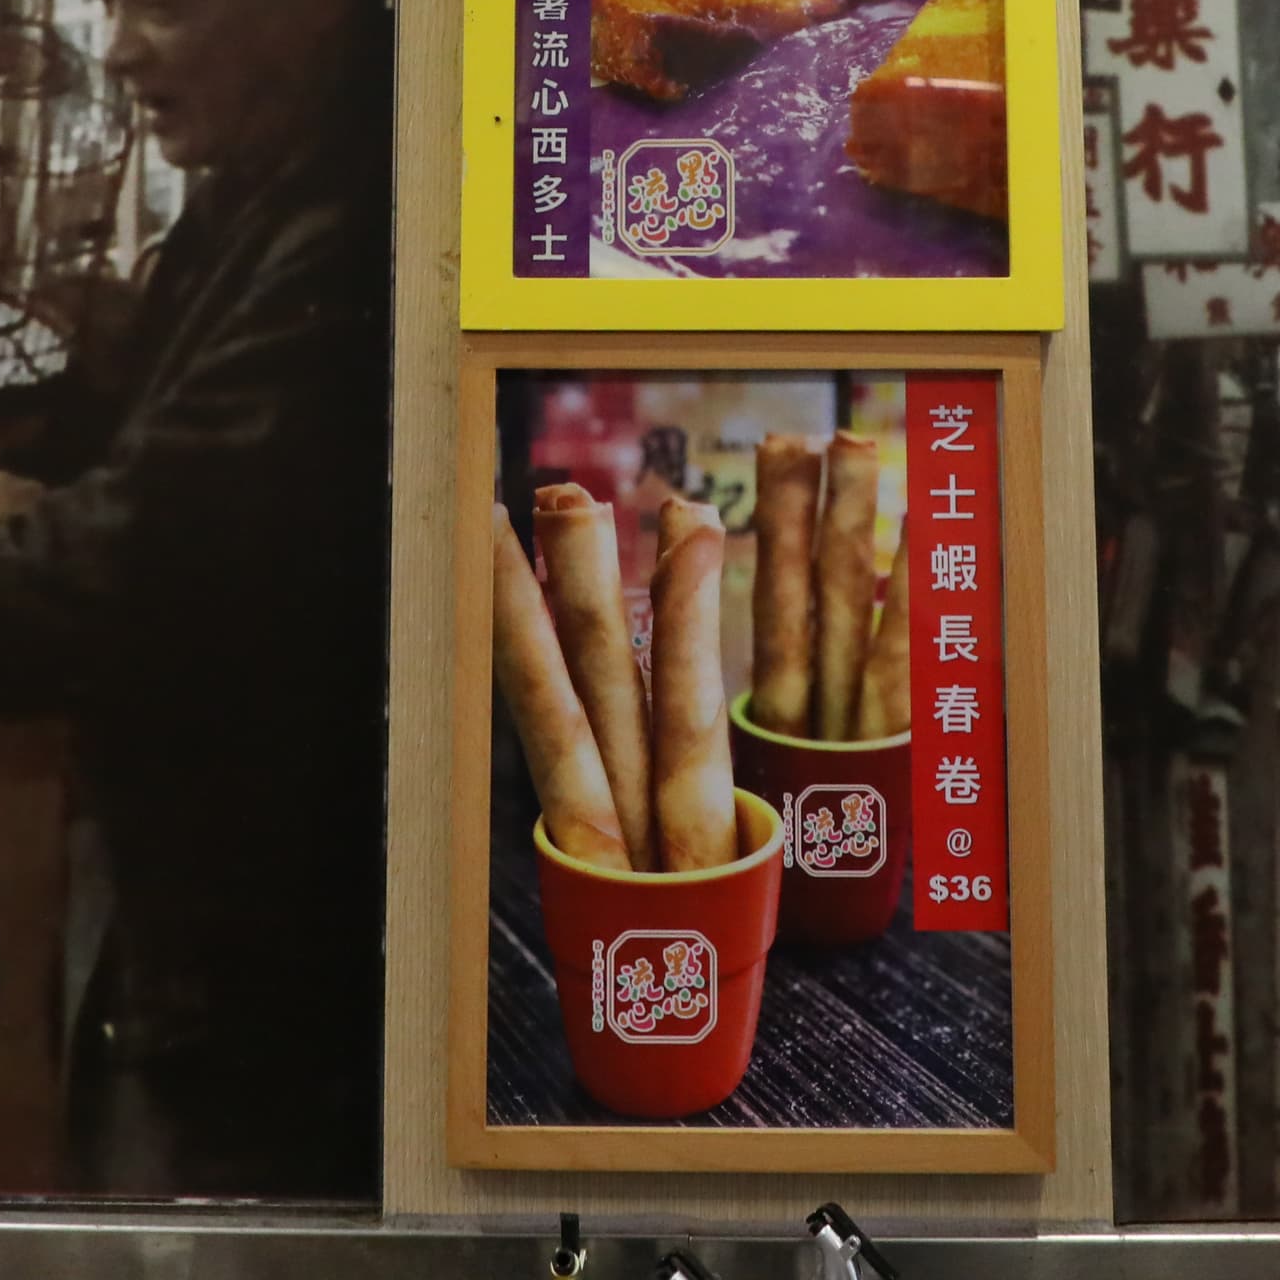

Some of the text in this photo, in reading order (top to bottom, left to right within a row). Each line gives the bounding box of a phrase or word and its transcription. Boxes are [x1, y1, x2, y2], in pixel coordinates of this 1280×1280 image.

[928, 405, 982, 805] 芝士蝦長春卷
[928, 874, 992, 904] $36
